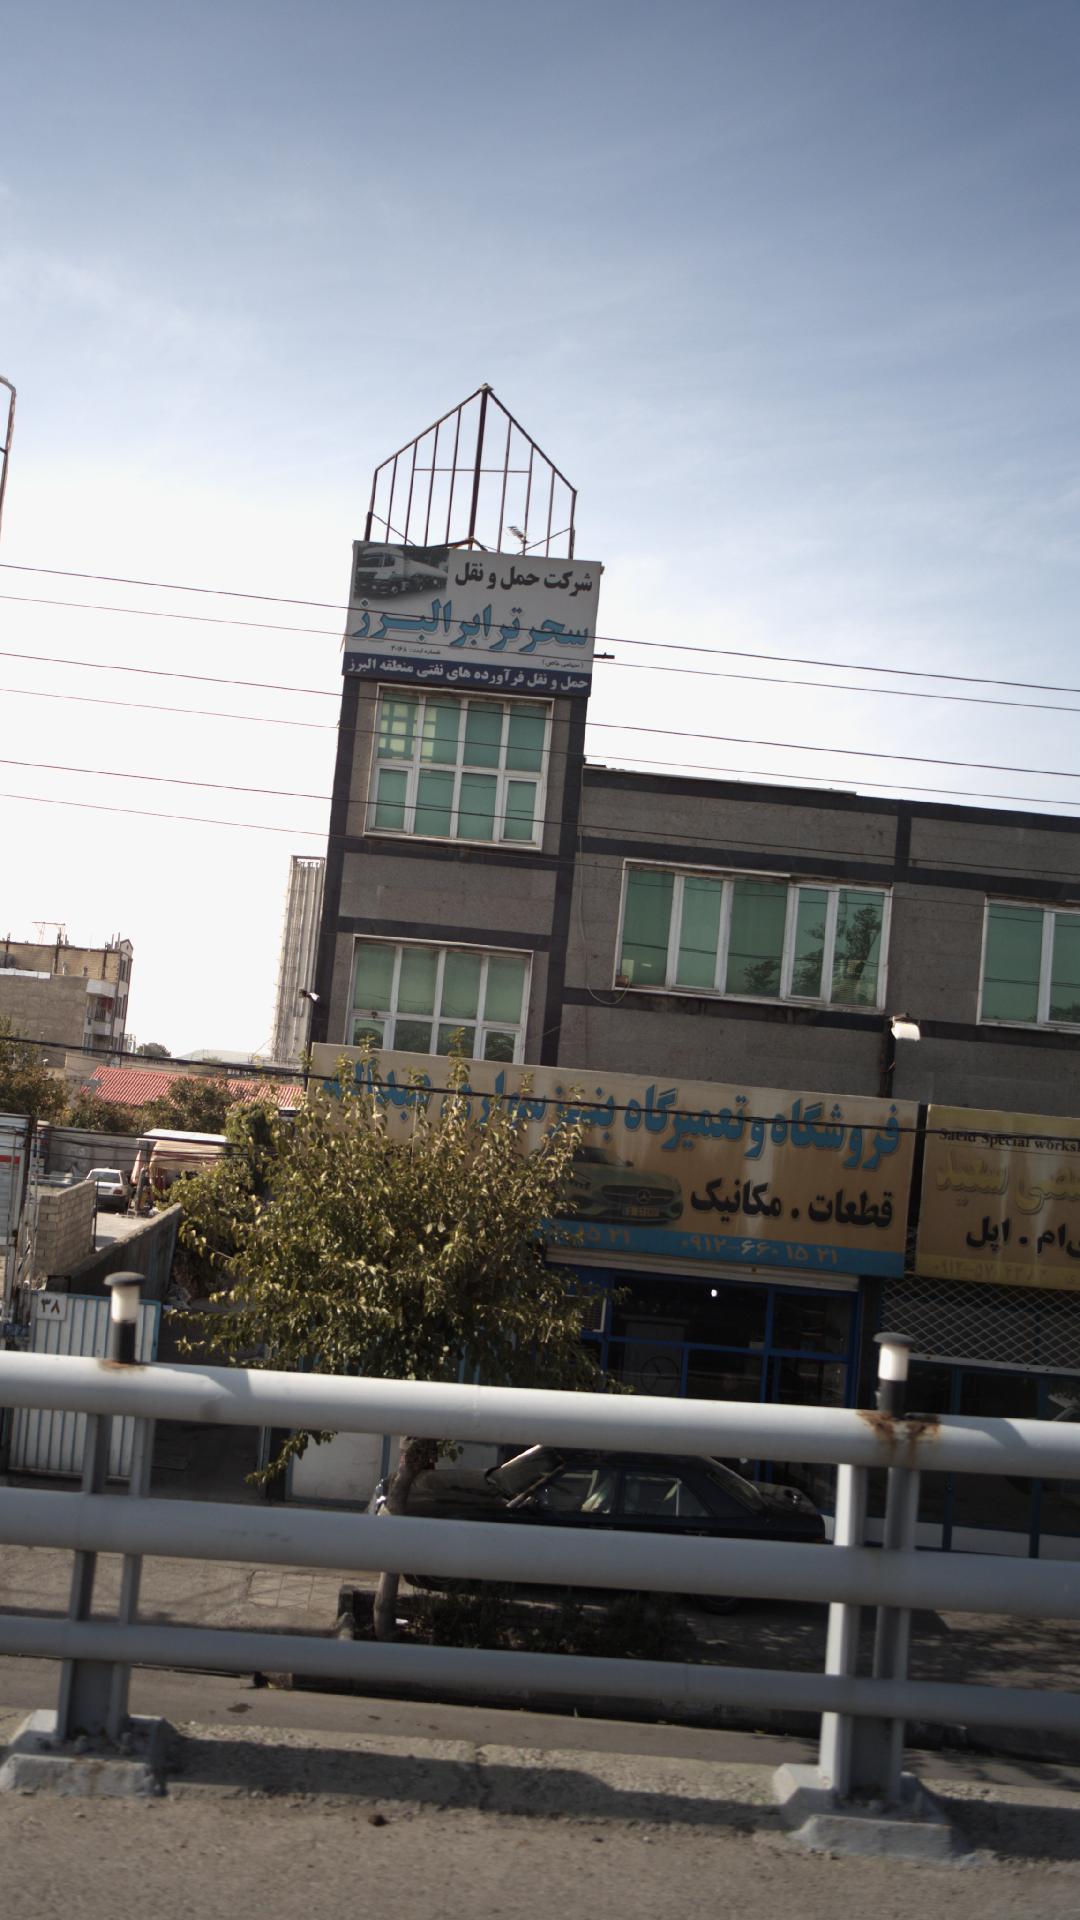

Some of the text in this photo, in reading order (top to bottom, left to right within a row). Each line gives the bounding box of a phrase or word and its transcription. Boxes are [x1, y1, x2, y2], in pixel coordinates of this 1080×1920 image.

[455, 561, 592, 596] شرکت حمل و نقل
[352, 598, 452, 639] البرز
[518, 619, 589, 653] سحر
[347, 658, 377, 672] البرز
[380, 660, 414, 672] منطقه
[416, 664, 444, 677] نفتی
[446, 666, 471, 680] های
[527, 673, 547, 687] نقل
[549, 680, 558, 690] و
[560, 675, 588, 690] حمل
[624, 1084, 747, 1149] تعمیرگاه
[745, 1118, 765, 1160] و
[770, 1098, 900, 1170] فروشگاه
[690, 1177, 894, 1228] قطعات مکانیک
[41, 1298, 60, 1315] ۳۸
